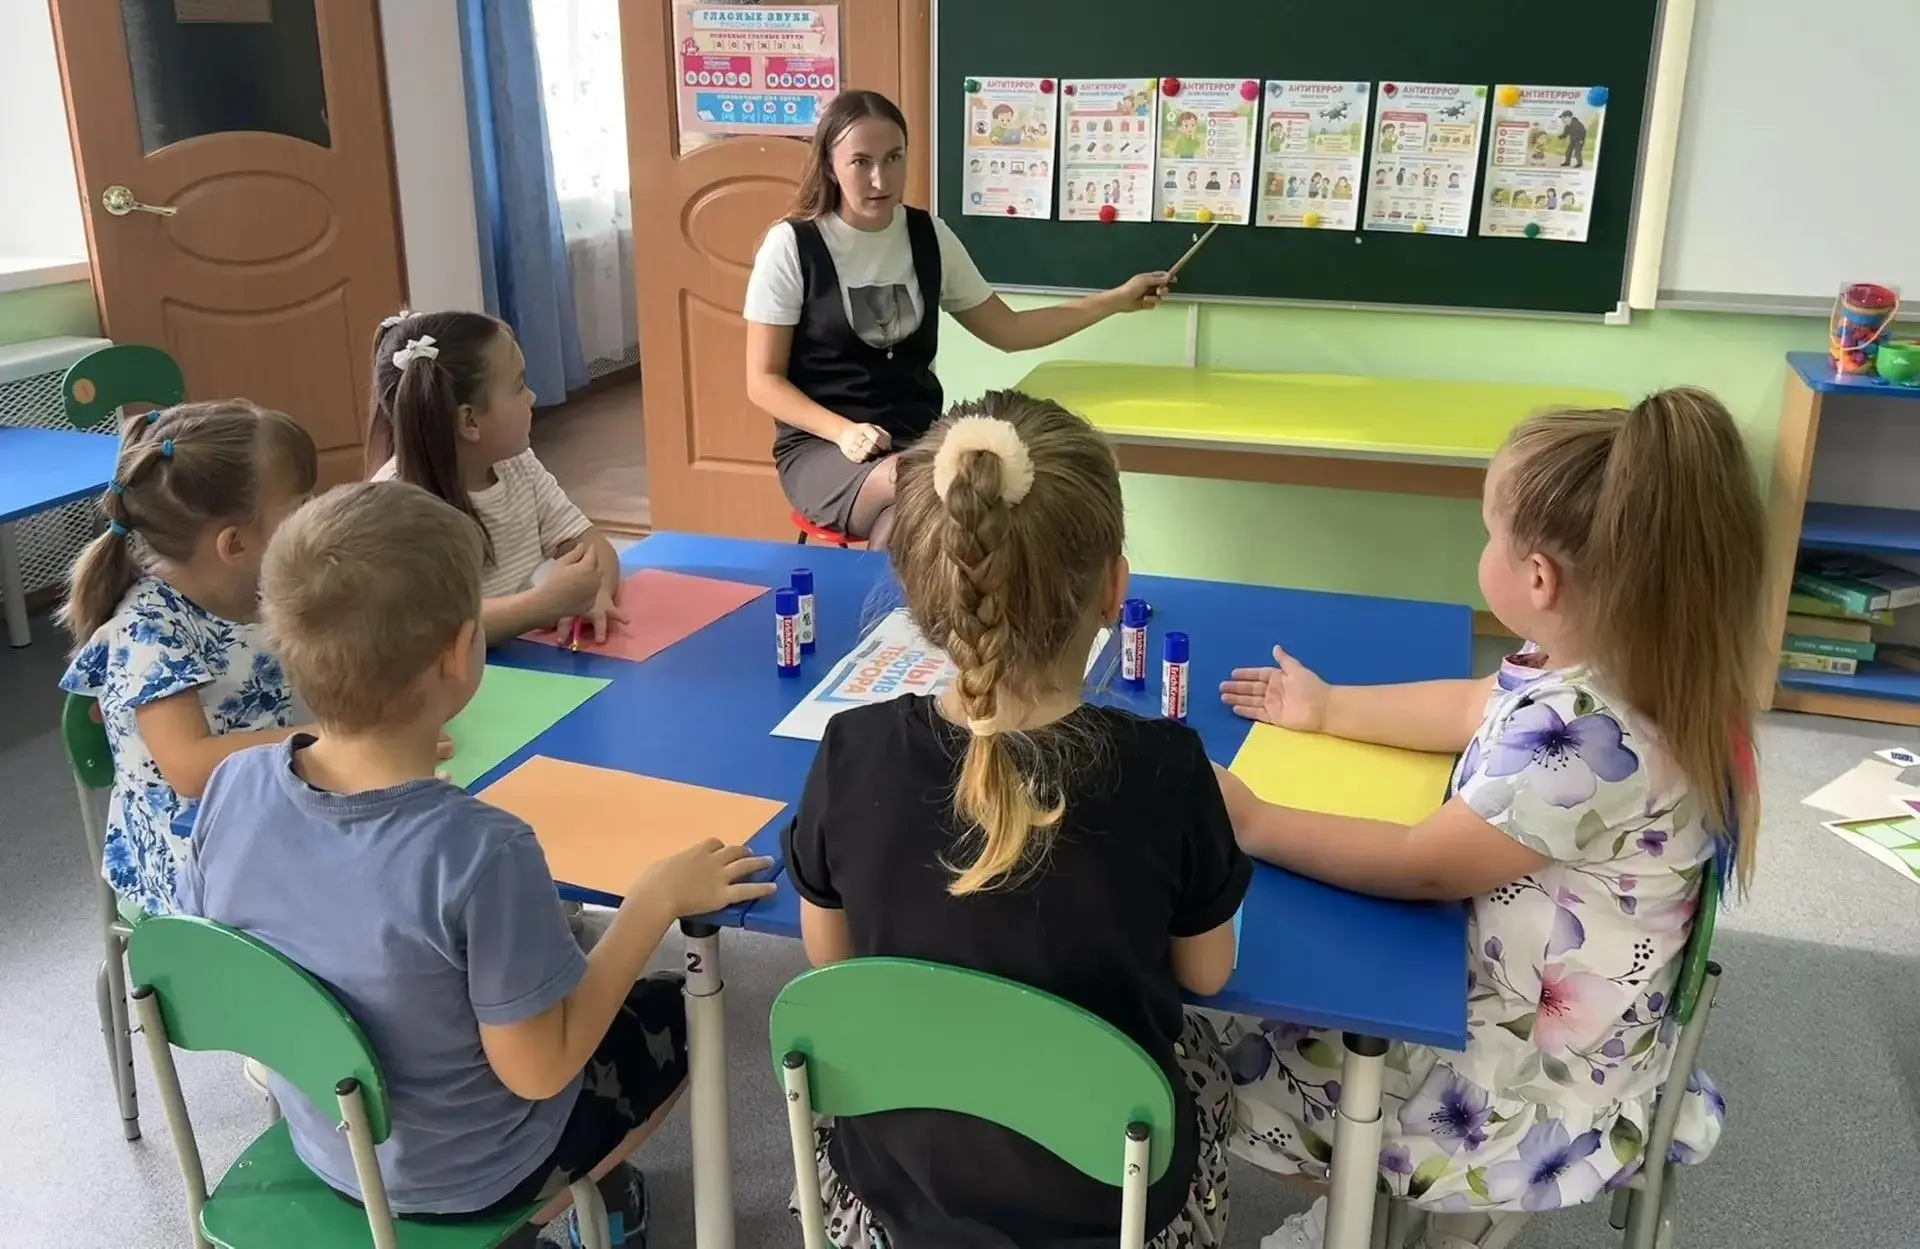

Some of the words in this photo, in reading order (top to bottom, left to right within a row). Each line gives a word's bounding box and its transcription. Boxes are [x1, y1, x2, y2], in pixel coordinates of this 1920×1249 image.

[703, 12, 763, 21] ГЛАСНЫЕ
[767, 12, 810, 21] ЗВУКИ
[987, 80, 1035, 89] АНТИТЕРРОР
[1080, 82, 1128, 91] АНТИТЕРРОР
[1183, 82, 1236, 91] АНТИТЕРРОР
[1288, 84, 1344, 93] АНТИТЕРРОР
[1402, 86, 1460, 96] АНТИТЕРРОР
[1519, 89, 1582, 100] АНТИТЕРРОР
[784, 619, 792, 665] ErichKrause
[1136, 631, 1144, 677] ErichKrause
[844, 646, 907, 693] ТЕРРОРА
[872, 650, 925, 692] ПРОТИВ
[902, 659, 945, 684] МЫ
[1169, 666, 1179, 717] ErichKrause
[686, 952, 703, 973] 2
